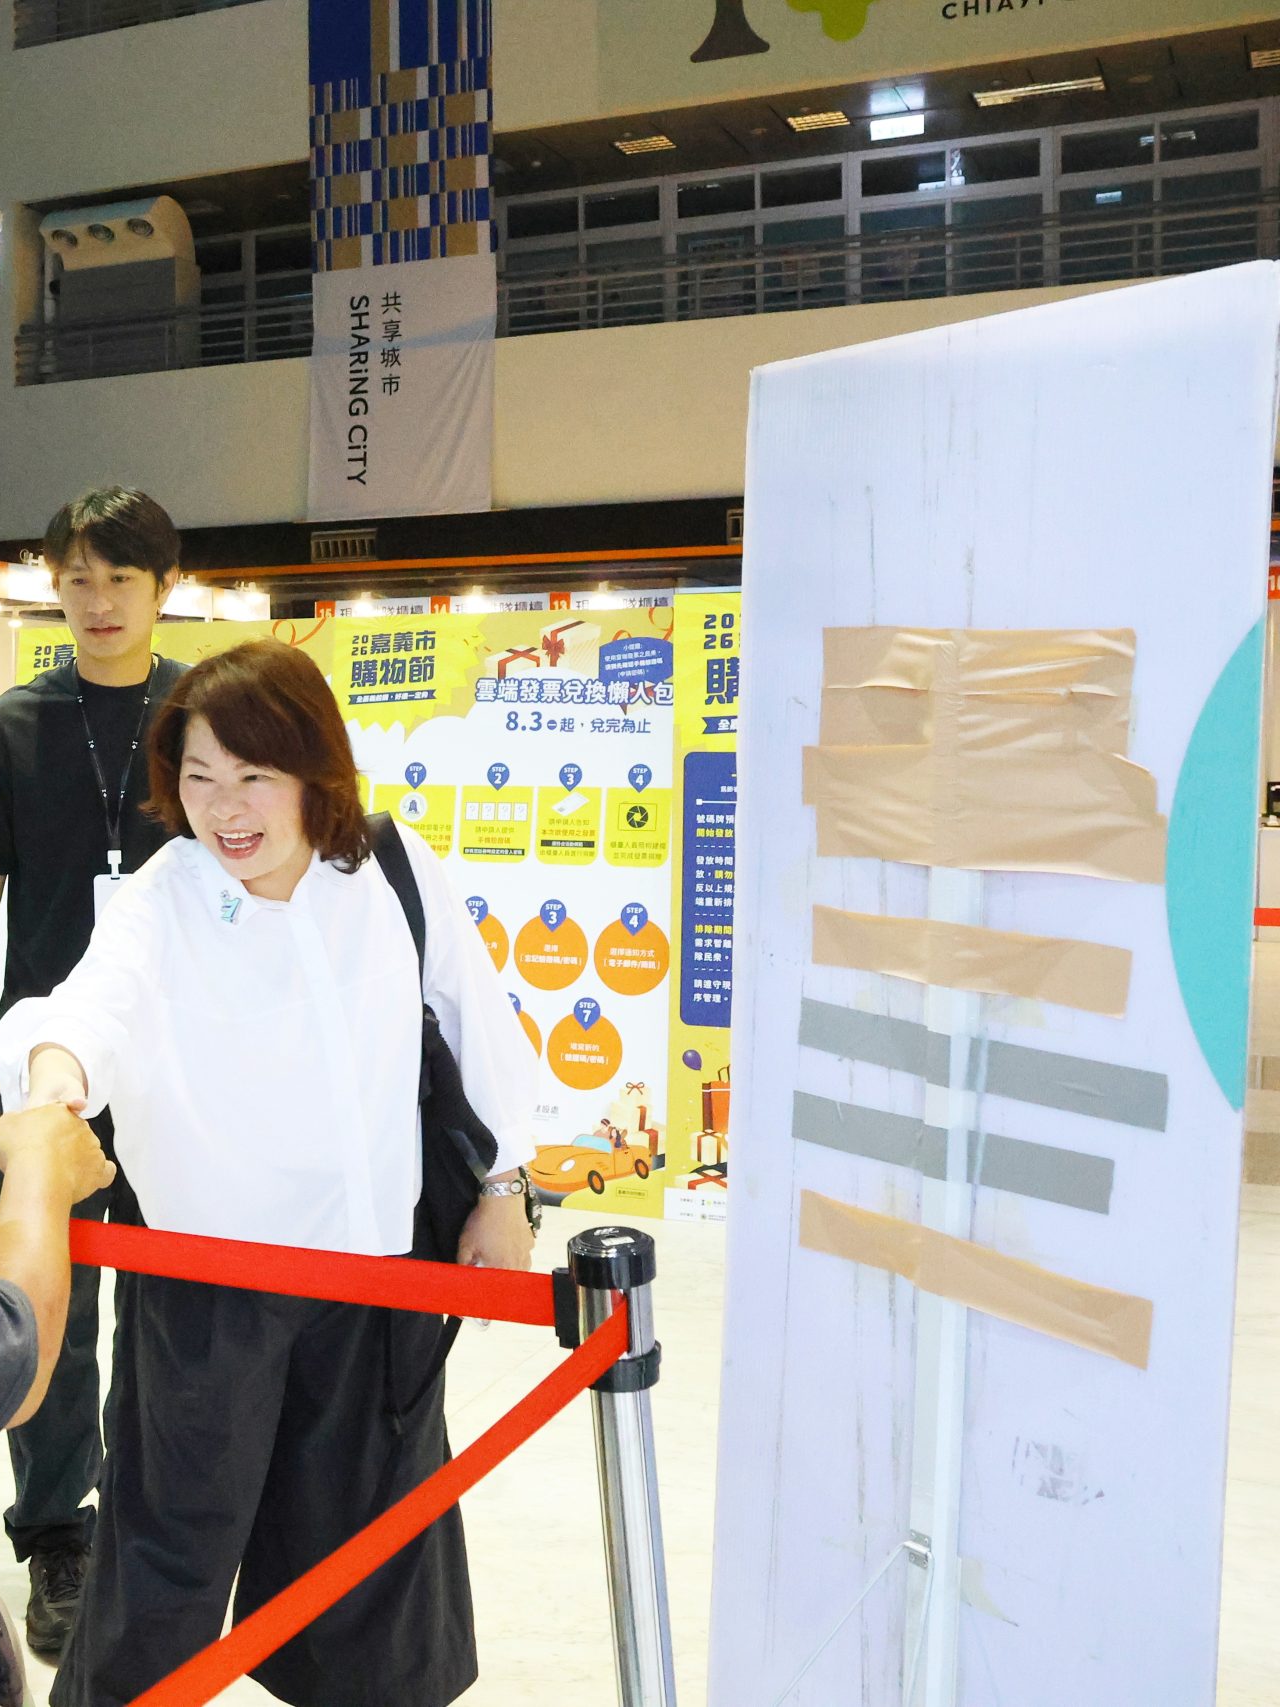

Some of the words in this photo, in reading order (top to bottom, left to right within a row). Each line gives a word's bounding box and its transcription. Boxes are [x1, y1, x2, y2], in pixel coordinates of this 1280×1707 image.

[942, 0, 1045, 20] CHIA
[380, 291, 402, 396] 共享城市
[704, 613, 734, 629] 20
[352, 635, 369, 645] 20
[370, 630, 436, 655] 嘉義市
[703, 633, 733, 649] 26
[34, 646, 52, 656] 20
[351, 646, 367, 656] 26
[33, 658, 50, 668] 26
[350, 656, 436, 688] 購物節
[475, 678, 673, 706] 雲端發票兌換懶人包
[412, 773, 418, 783] 1
[494, 773, 502, 784] 2
[567, 774, 574, 785] 3
[635, 775, 644, 785] 4
[695, 883, 735, 893] 反以上規
[471, 908, 479, 920] 2
[549, 912, 557, 924] 3
[629, 915, 638, 928] 4
[583, 1010, 591, 1022] 7
